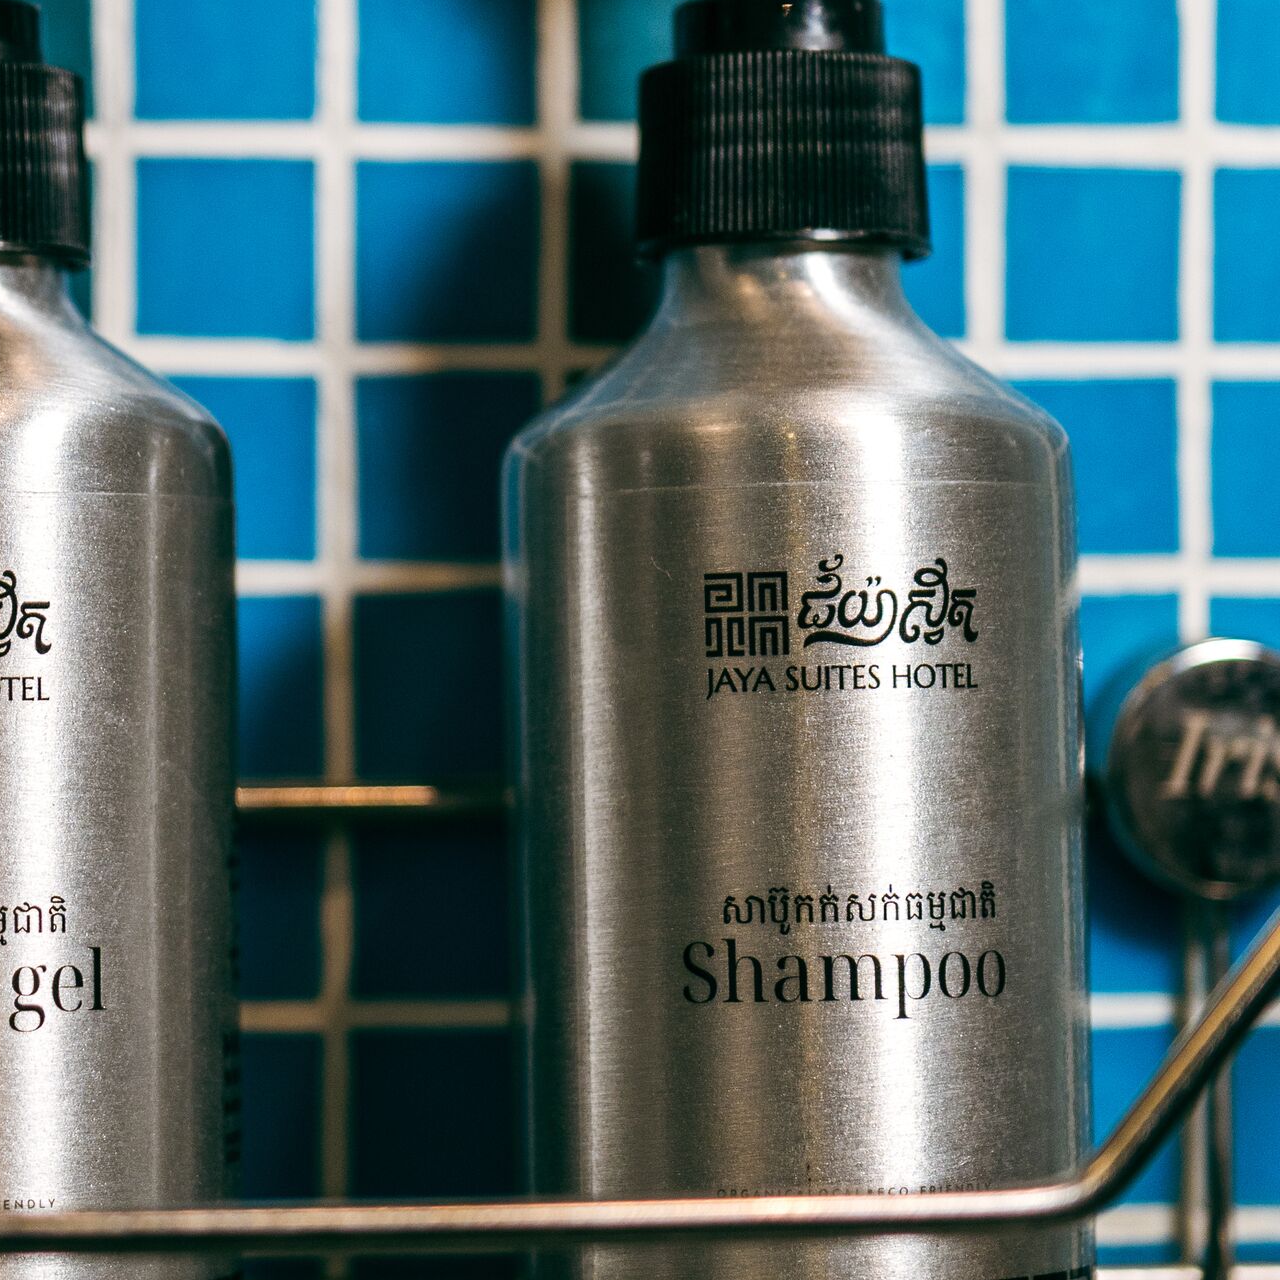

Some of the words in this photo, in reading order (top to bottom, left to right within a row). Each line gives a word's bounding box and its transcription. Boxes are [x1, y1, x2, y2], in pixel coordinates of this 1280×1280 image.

[706, 667, 776, 700] JAYA
[785, 664, 881, 691] SUITES
[892, 663, 978, 689] HOTEL
[8, 946, 106, 1033] gel
[682, 938, 1007, 1020] Shampoo
